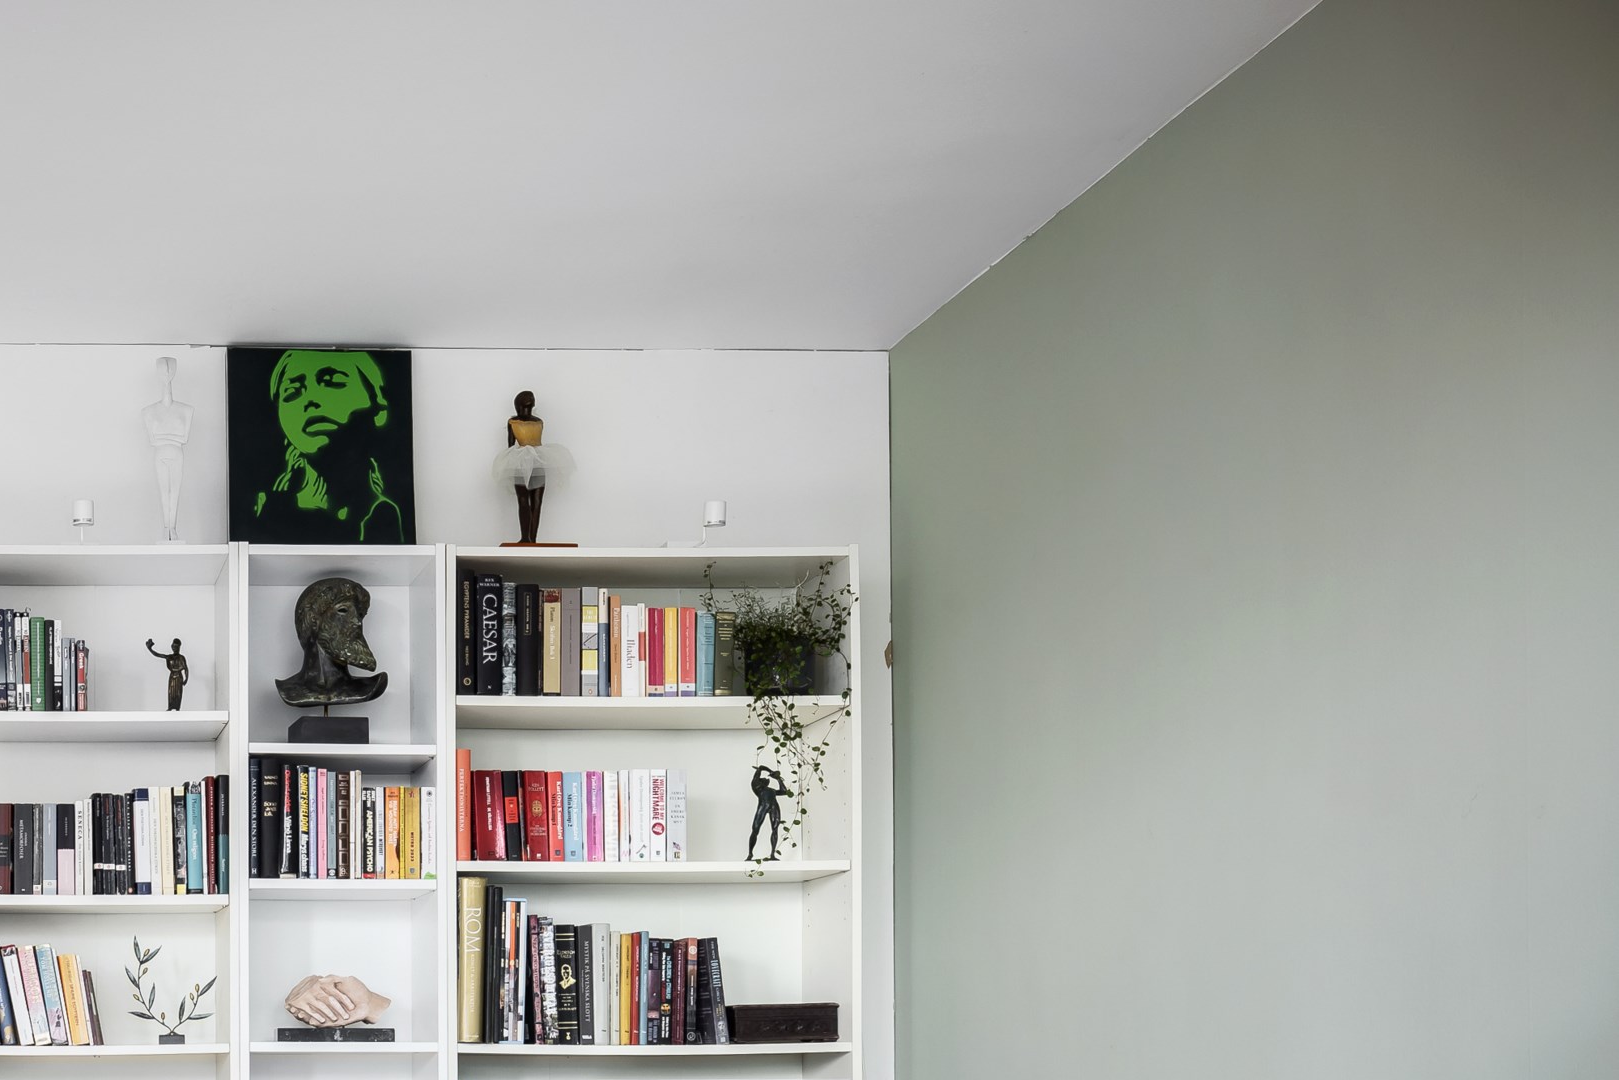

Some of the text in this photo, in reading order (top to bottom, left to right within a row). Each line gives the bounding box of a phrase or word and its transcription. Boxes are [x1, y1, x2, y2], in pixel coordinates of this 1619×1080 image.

[482, 593, 498, 665] CAESAR
[626, 639, 636, 669] Iliaden
[300, 772, 308, 799] SIDNEY
[300, 798, 308, 832] SHELDON
[365, 810, 373, 846] AMERICAN
[300, 833, 308, 853] Marys
[464, 906, 482, 953] ROM
[710, 959, 722, 988] LOVECRAFT
[584, 1001, 592, 1023] SLOTT
